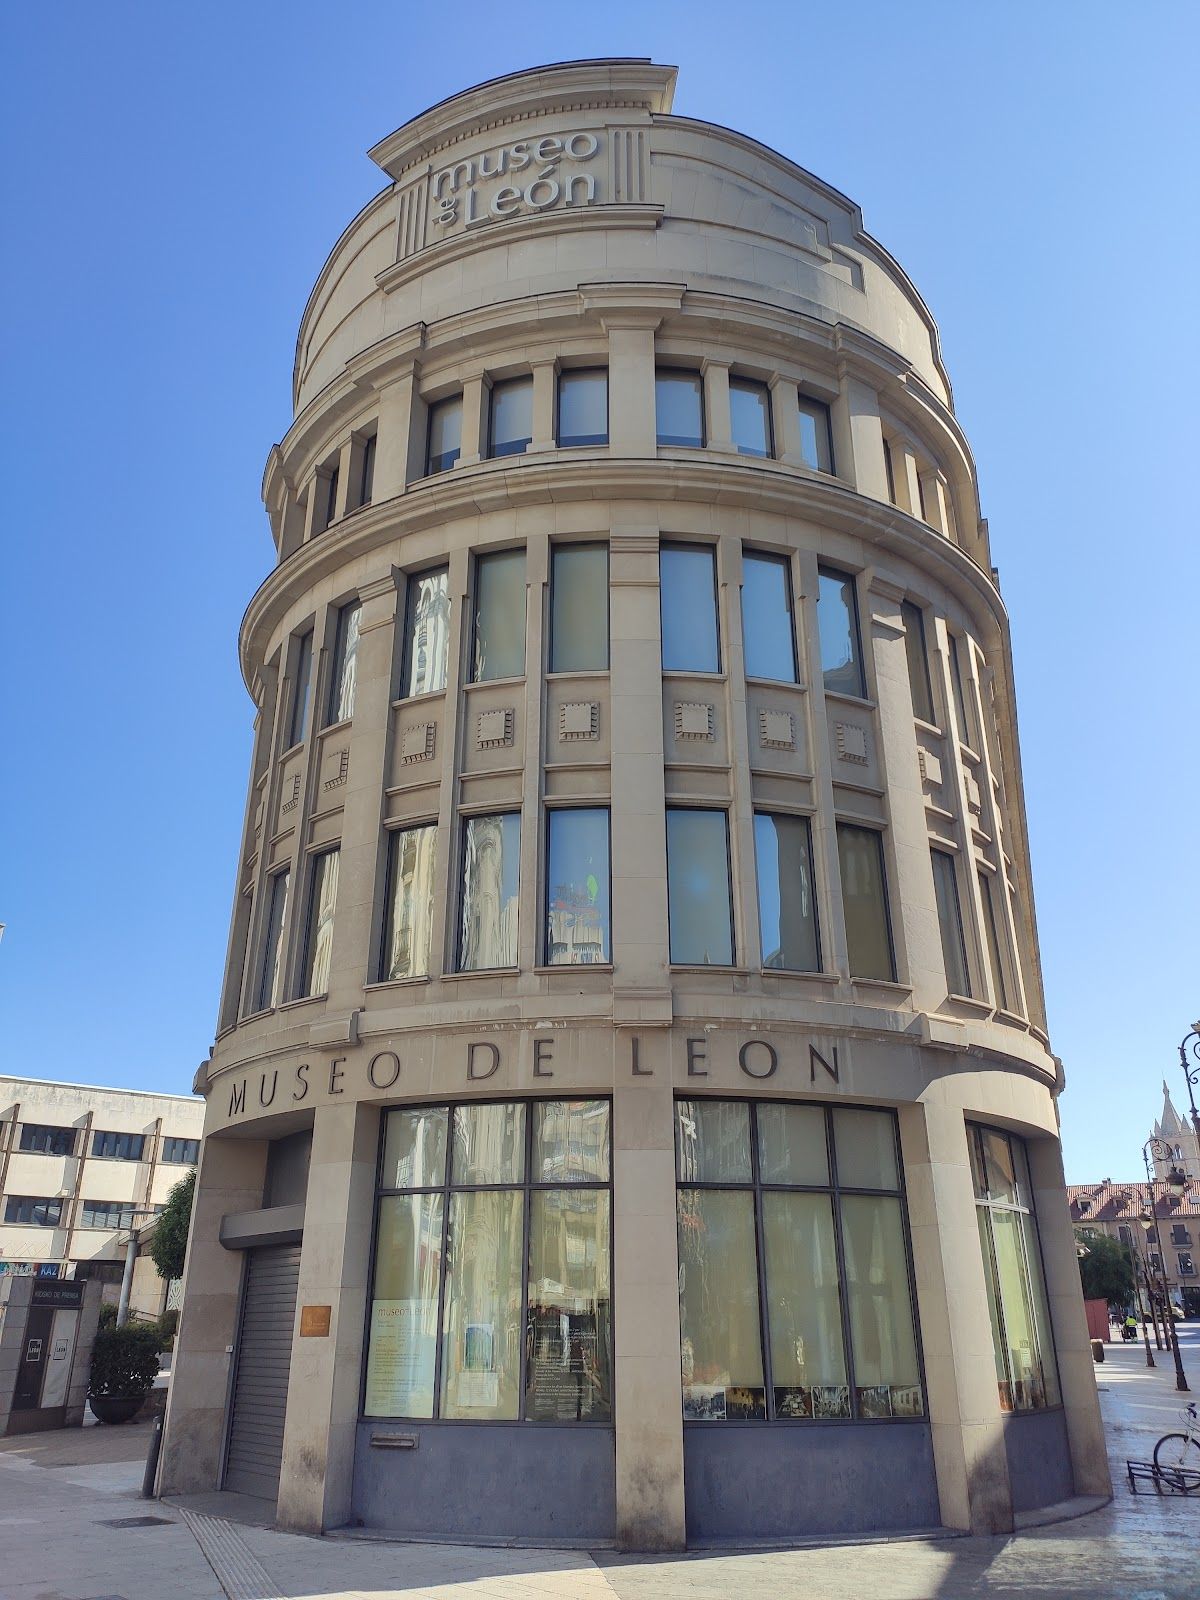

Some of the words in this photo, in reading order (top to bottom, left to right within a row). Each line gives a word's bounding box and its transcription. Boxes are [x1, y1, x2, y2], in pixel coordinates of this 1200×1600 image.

[432, 133, 598, 200] museo
[464, 165, 596, 229] León
[229, 1050, 401, 1117] MUSEO
[466, 1039, 555, 1081] DE
[631, 1037, 840, 1084] LEON
